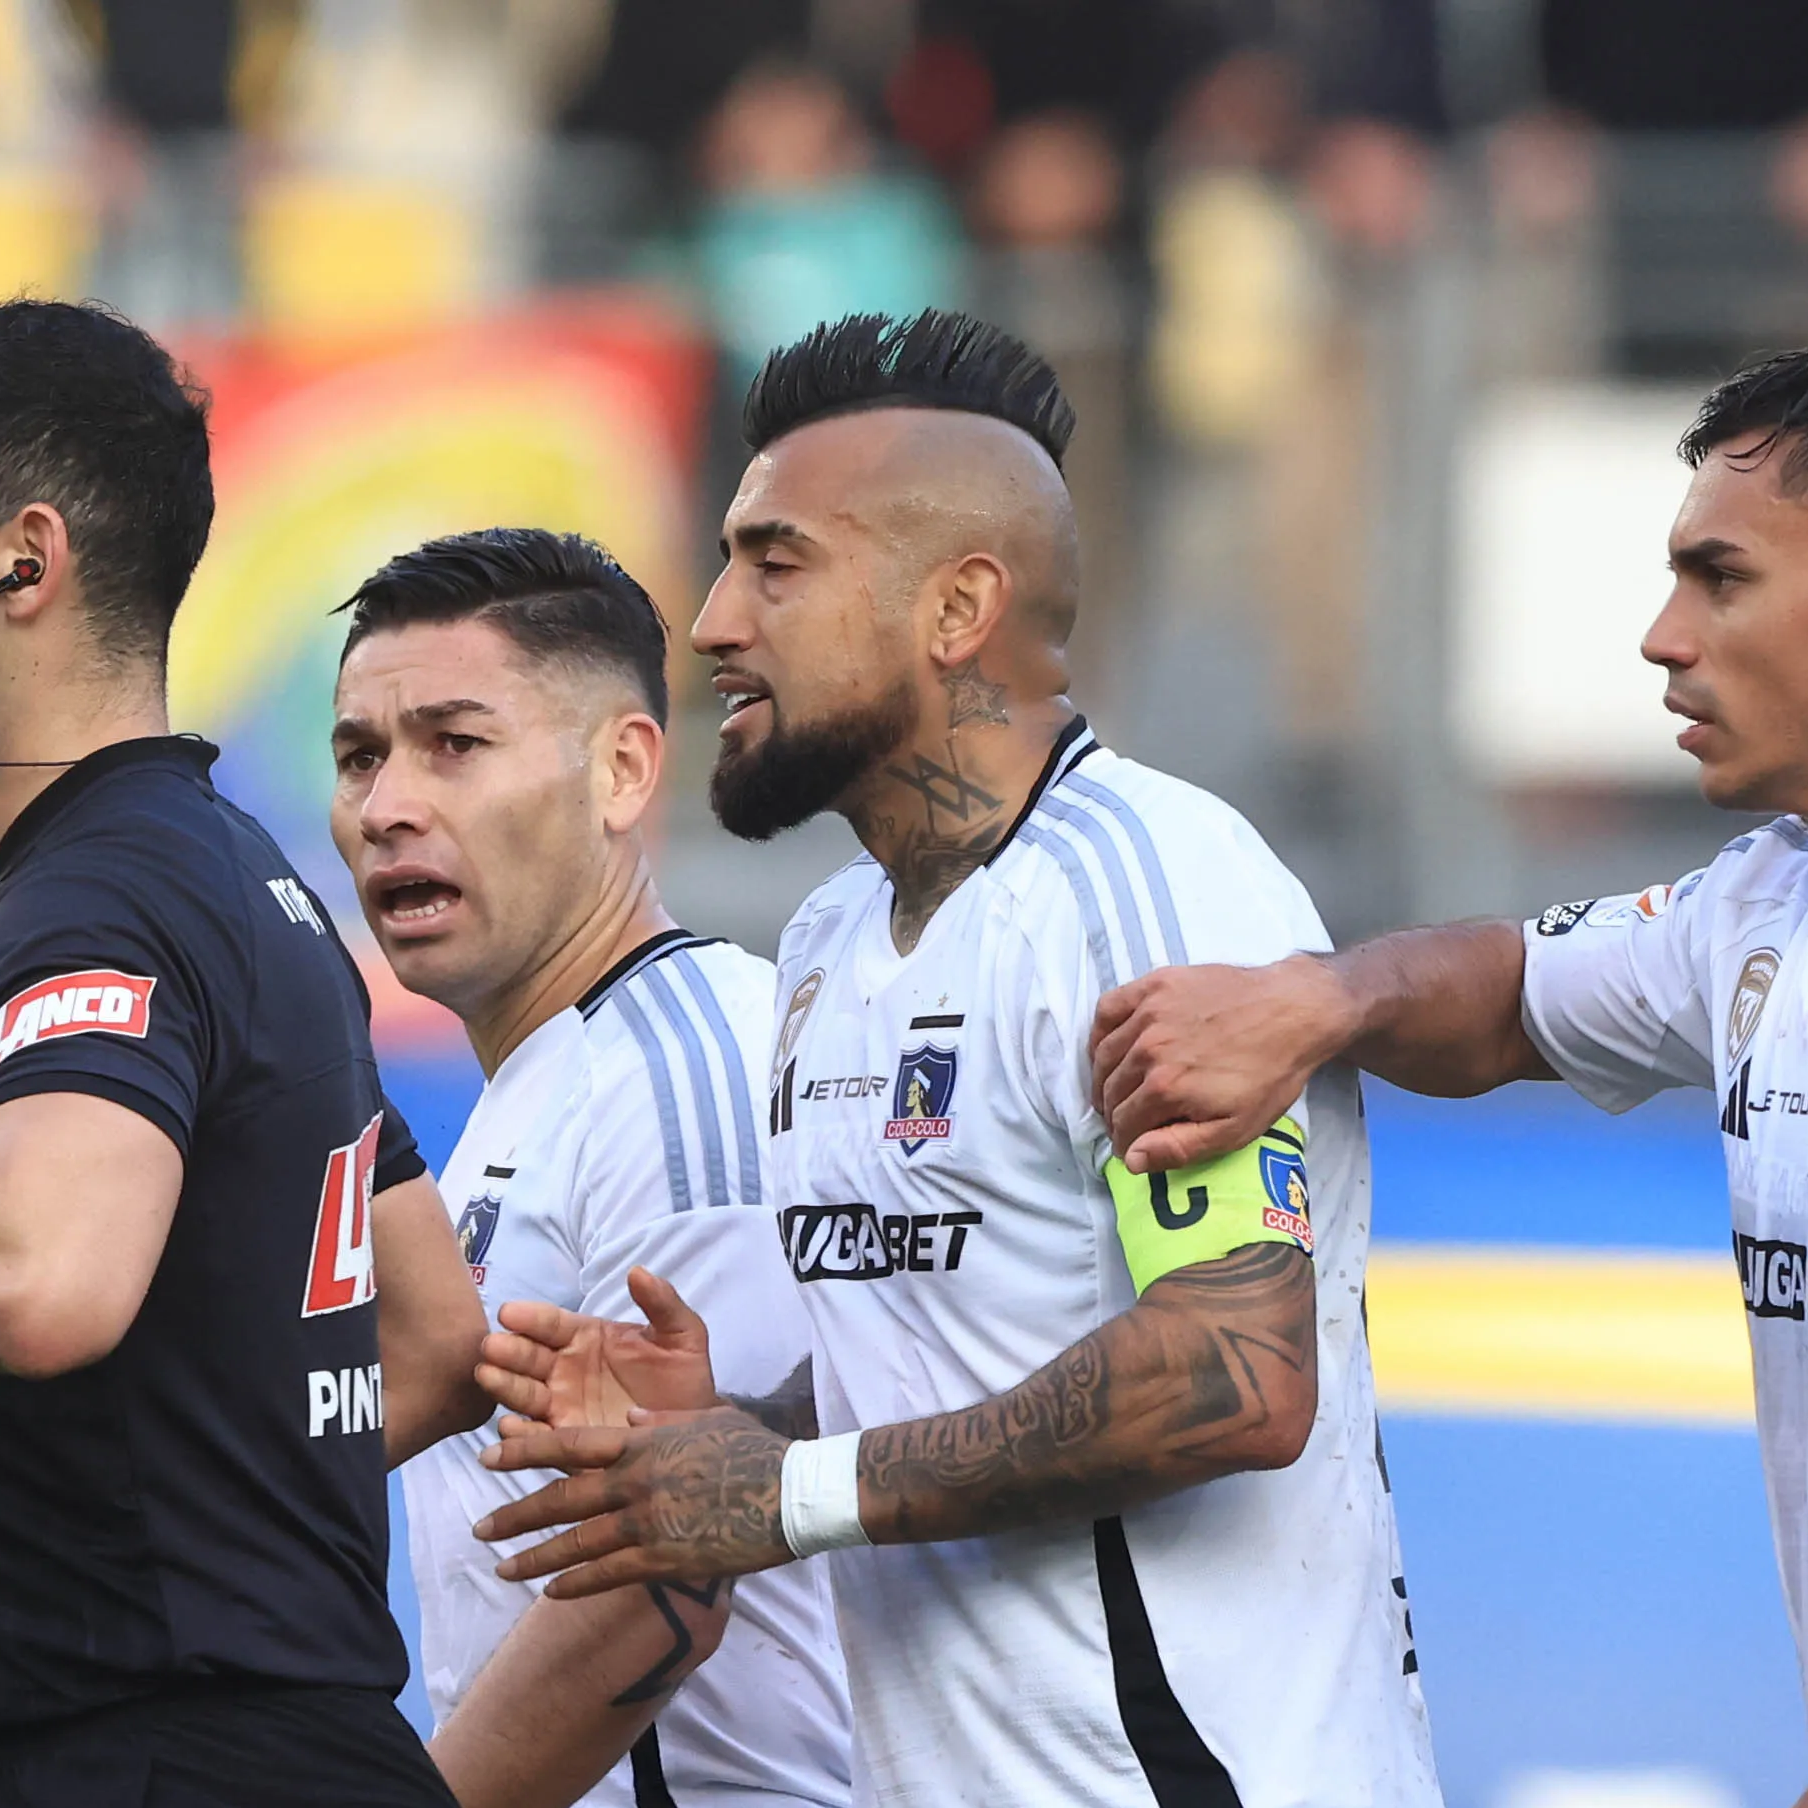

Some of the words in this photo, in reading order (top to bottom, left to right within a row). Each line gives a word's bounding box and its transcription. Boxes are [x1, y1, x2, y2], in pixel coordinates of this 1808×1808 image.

[799, 1075, 889, 1101] JETOUR
[887, 1120, 948, 1139] COLO-COLO
[1148, 1165, 1209, 1230] C
